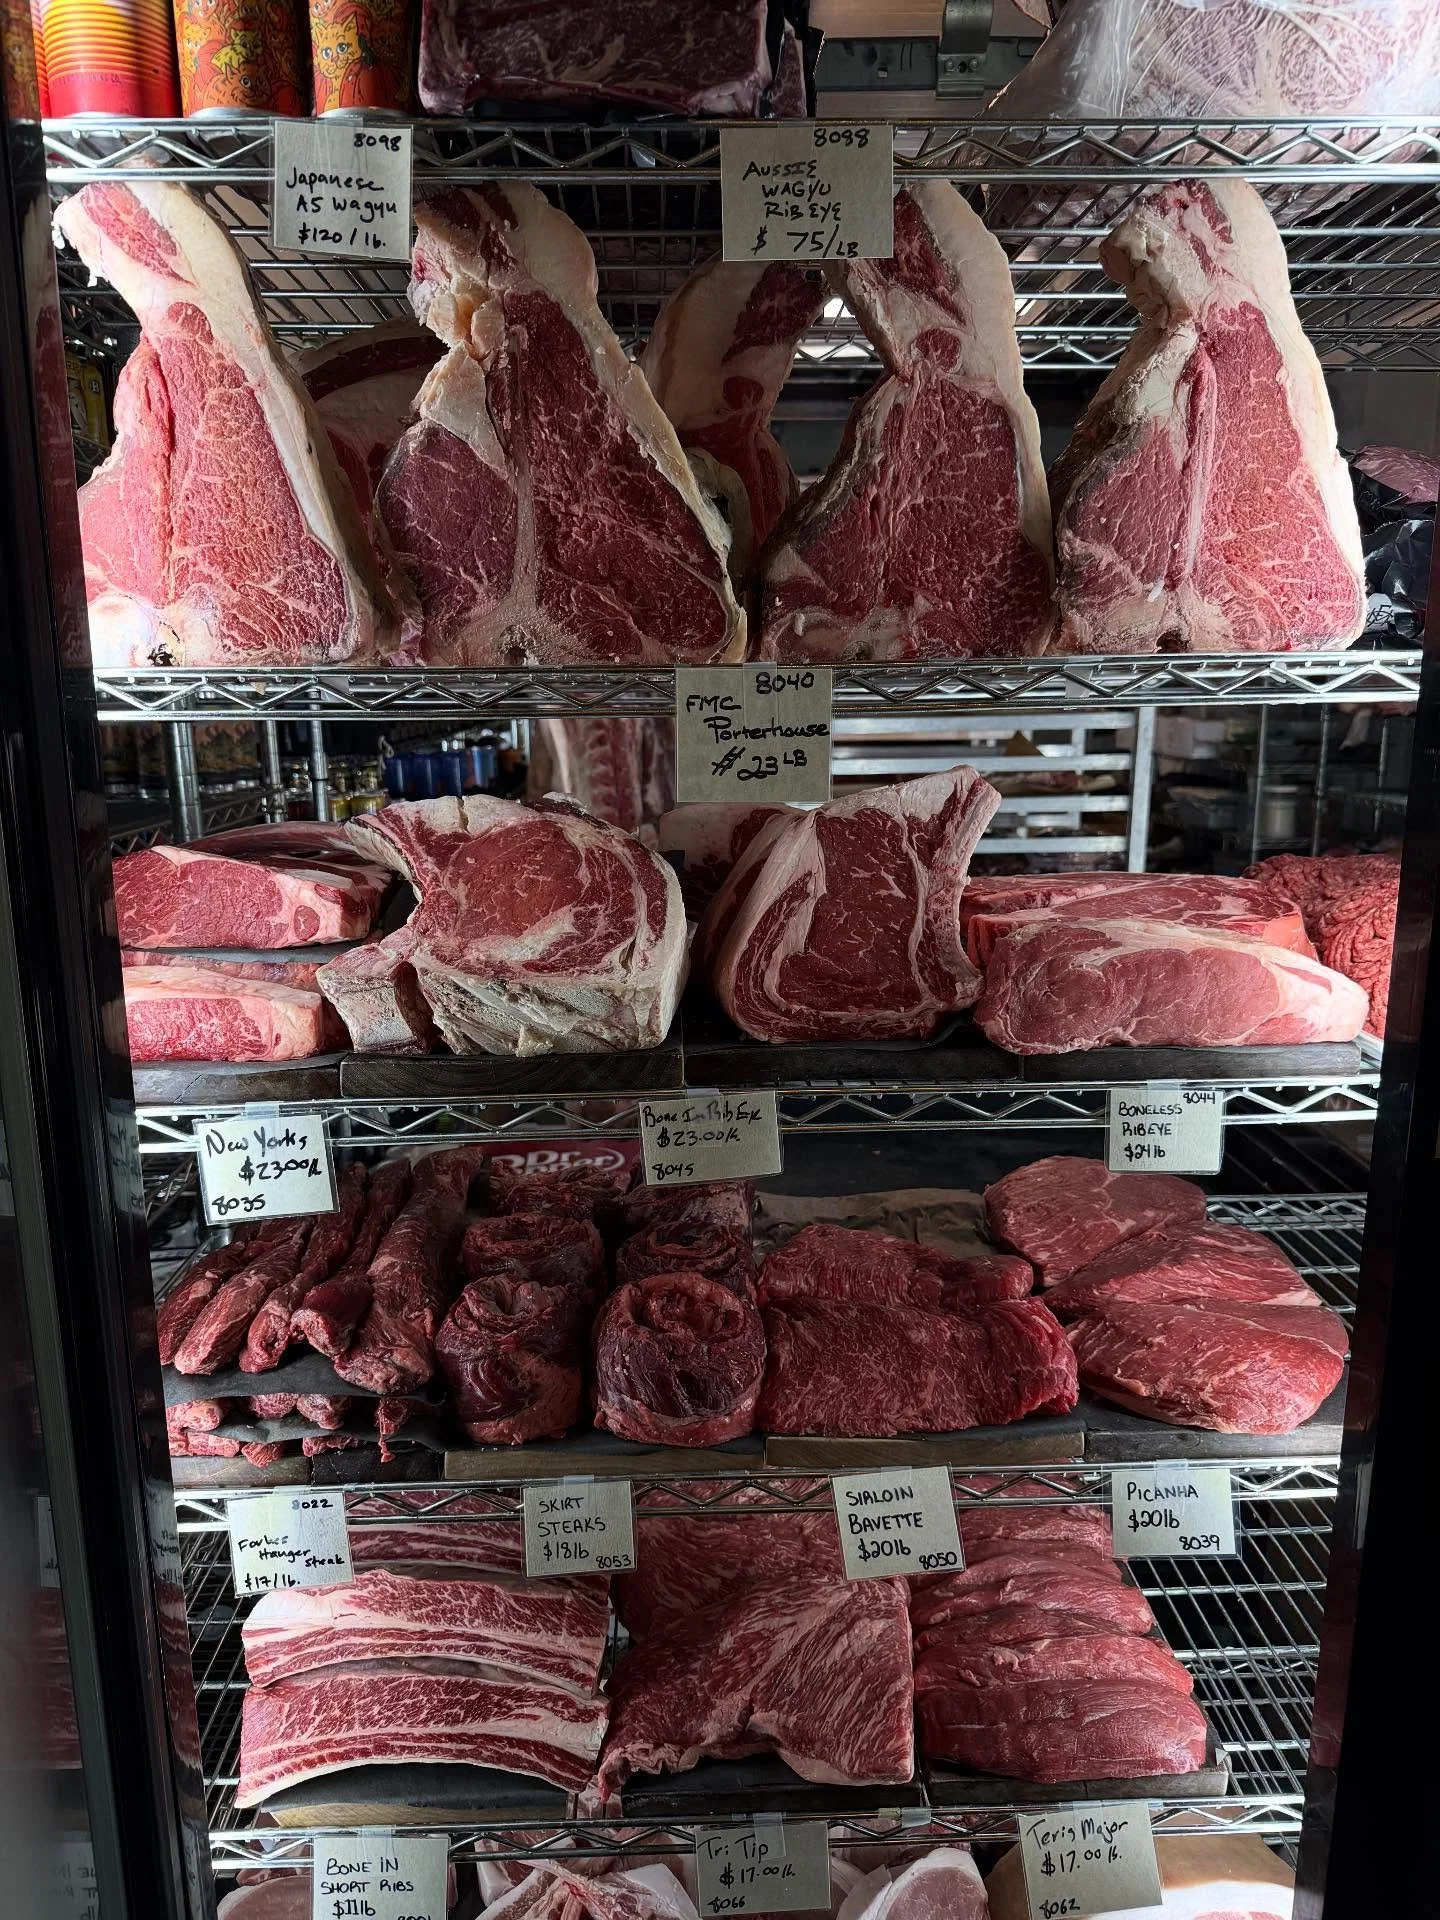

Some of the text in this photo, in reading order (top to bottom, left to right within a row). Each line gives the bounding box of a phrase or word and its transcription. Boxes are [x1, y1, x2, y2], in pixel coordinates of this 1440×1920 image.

[354, 133, 401, 151] 8098
[286, 166, 384, 193] Japanese
[743, 160, 817, 180] AUSSIE
[762, 180, 831, 202] WAGYU
[296, 194, 323, 213] A5
[756, 671, 814, 694] 8040
[686, 695, 742, 713] FMC
[703, 716, 830, 744] Porterhouse
[1183, 1092, 1216, 1104] 8044
[643, 1106, 678, 1127] Bone
[1119, 1101, 1182, 1117] BONELESS
[1122, 1121, 1172, 1137] RIBEYE
[205, 1126, 308, 1158] New Yorks
[652, 1163, 695, 1181] 8045
[211, 1193, 266, 1216] 8035
[845, 1485, 914, 1507] SIRLOIN
[1127, 1482, 1199, 1502] PICANHA
[539, 1497, 585, 1514] SKIRT
[537, 1517, 606, 1537] STEAKS
[848, 1511, 924, 1535] BAVETTE
[1178, 1534, 1220, 1552] 8039
[259, 1548, 311, 1563] Hanger
[595, 1554, 632, 1569] 8053
[918, 1551, 958, 1570] 8050
[1080, 1817, 1129, 1845] Major
[697, 1833, 769, 1864] Tri Tip
[326, 1857, 373, 1875] BONE
[320, 1879, 415, 1895] SHORT RIBS
[707, 1895, 746, 1914] 8066
[1039, 1897, 1081, 1920] 8062
